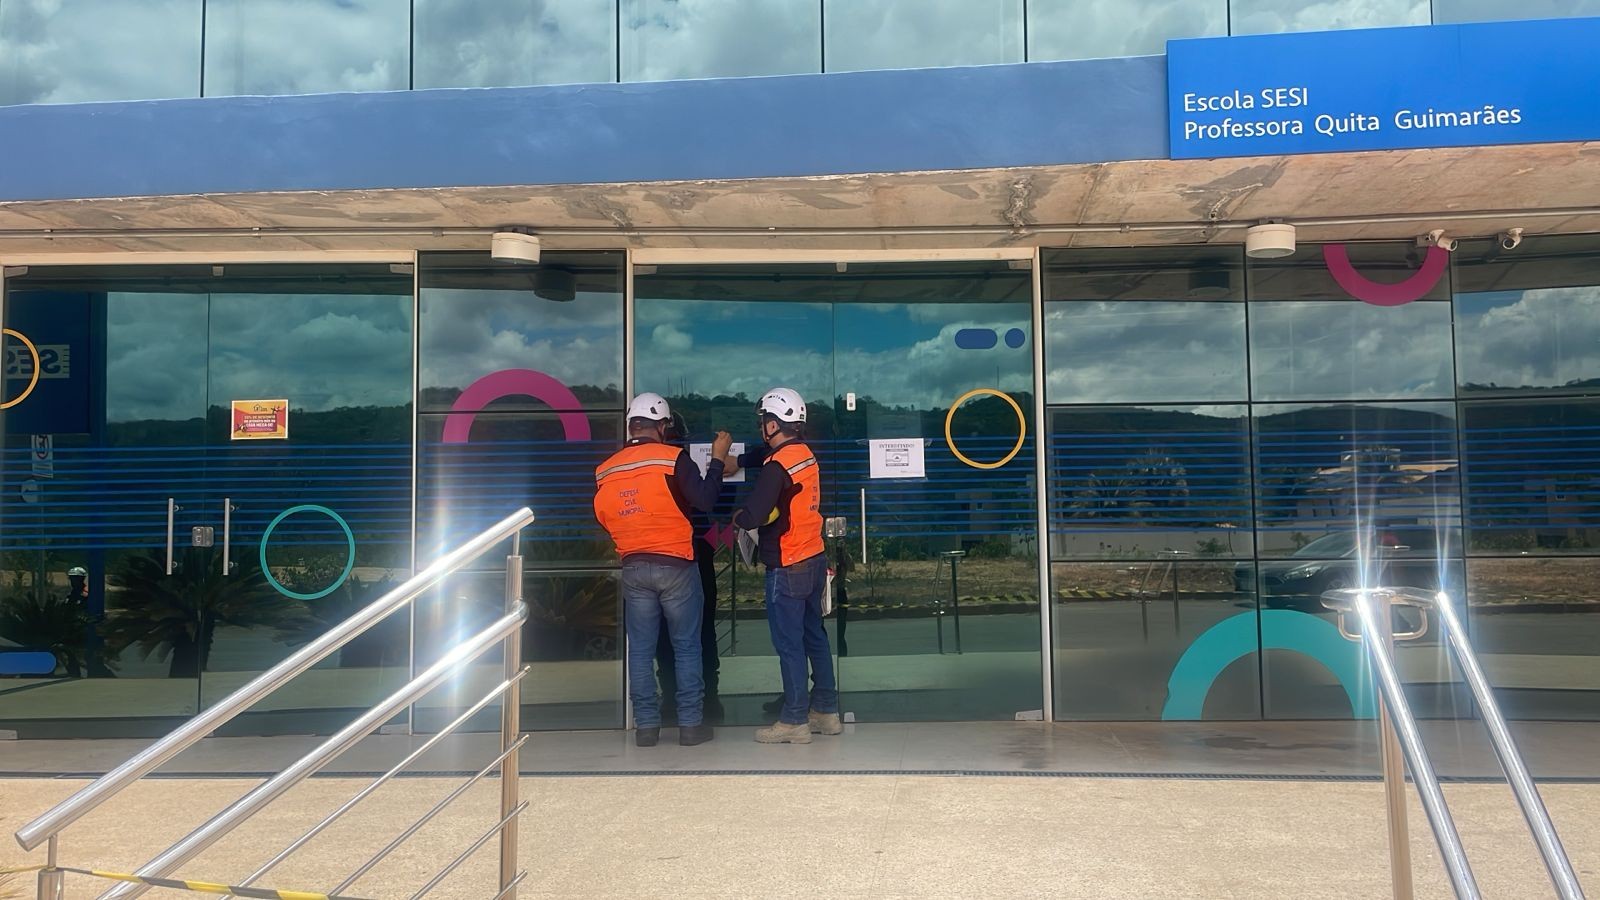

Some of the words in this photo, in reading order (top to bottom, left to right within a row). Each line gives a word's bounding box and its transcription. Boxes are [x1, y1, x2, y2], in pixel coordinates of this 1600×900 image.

[1184, 90, 1254, 112] Escola
[1261, 87, 1308, 109] SESI
[1185, 118, 1303, 140] Professora
[1315, 113, 1380, 137] Quita
[1394, 105, 1522, 129] Guimarães
